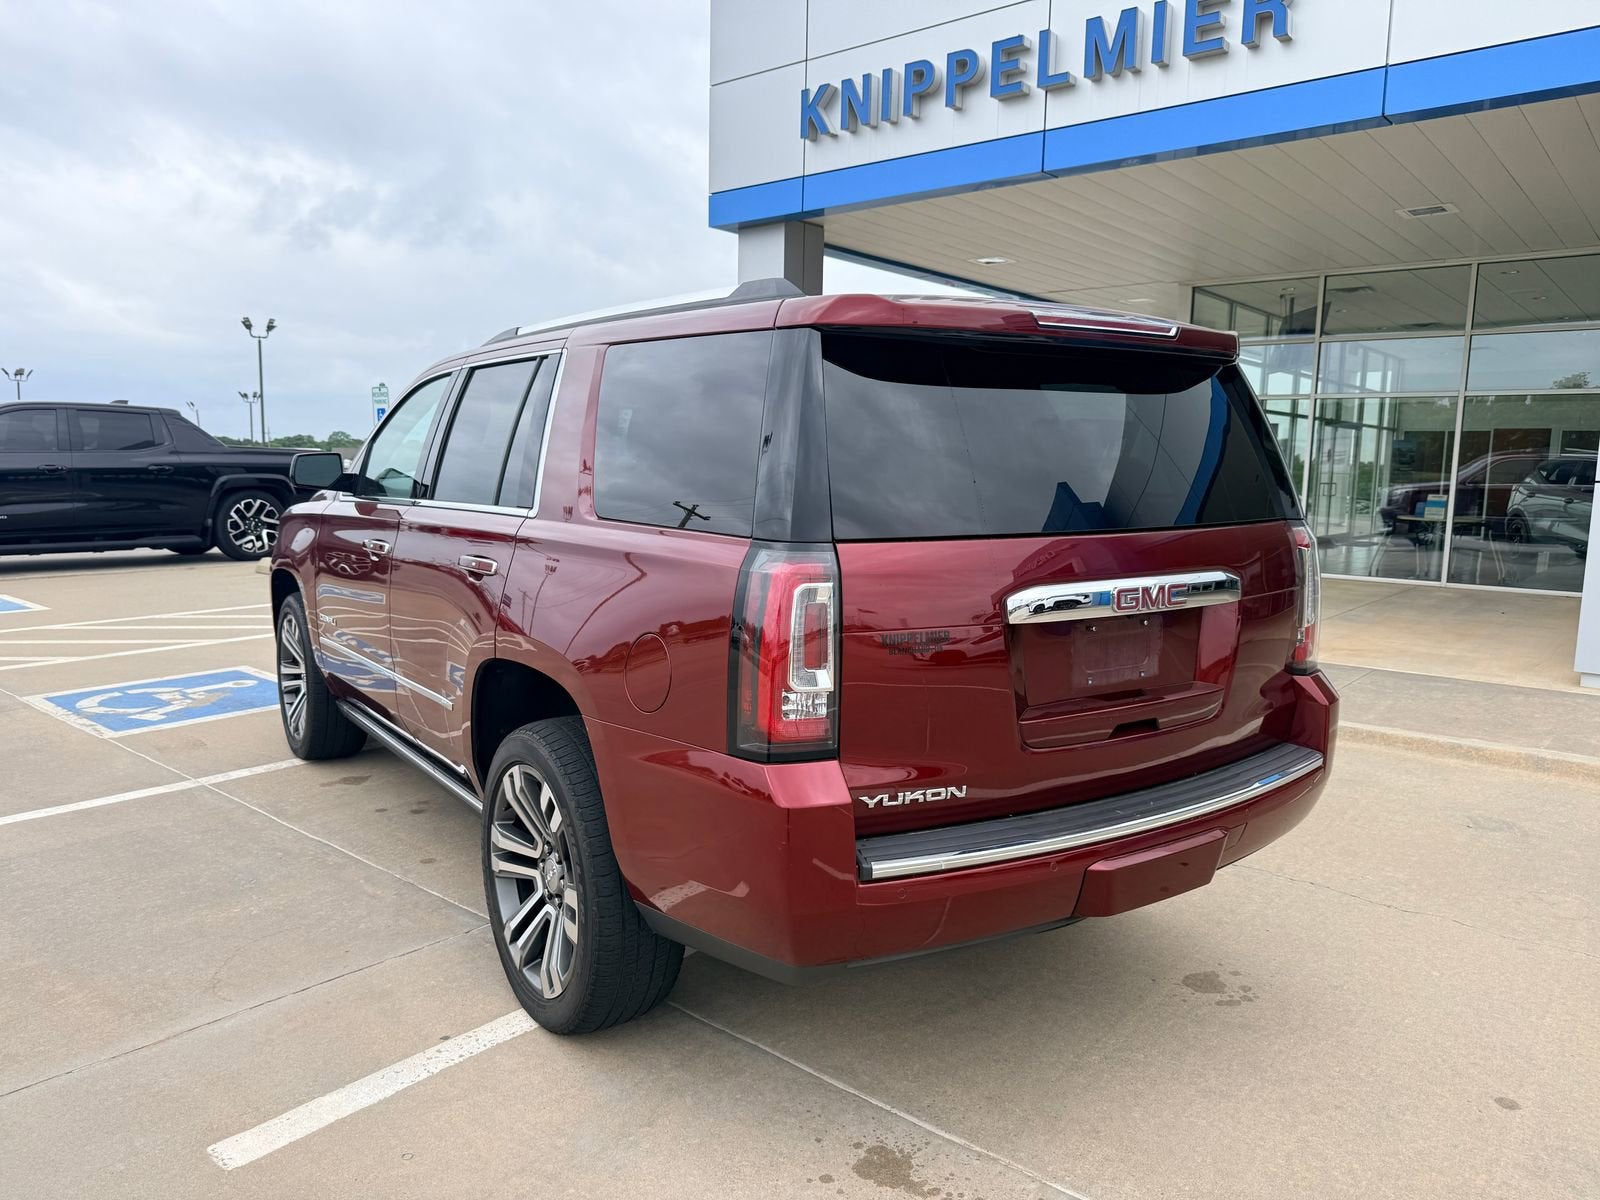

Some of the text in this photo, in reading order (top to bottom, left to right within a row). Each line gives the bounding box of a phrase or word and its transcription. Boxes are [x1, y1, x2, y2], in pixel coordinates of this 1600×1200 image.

[800, 0, 1294, 141] KNIPPELMIER
[1115, 583, 1188, 612] GMC
[859, 785, 967, 809] YUKON
